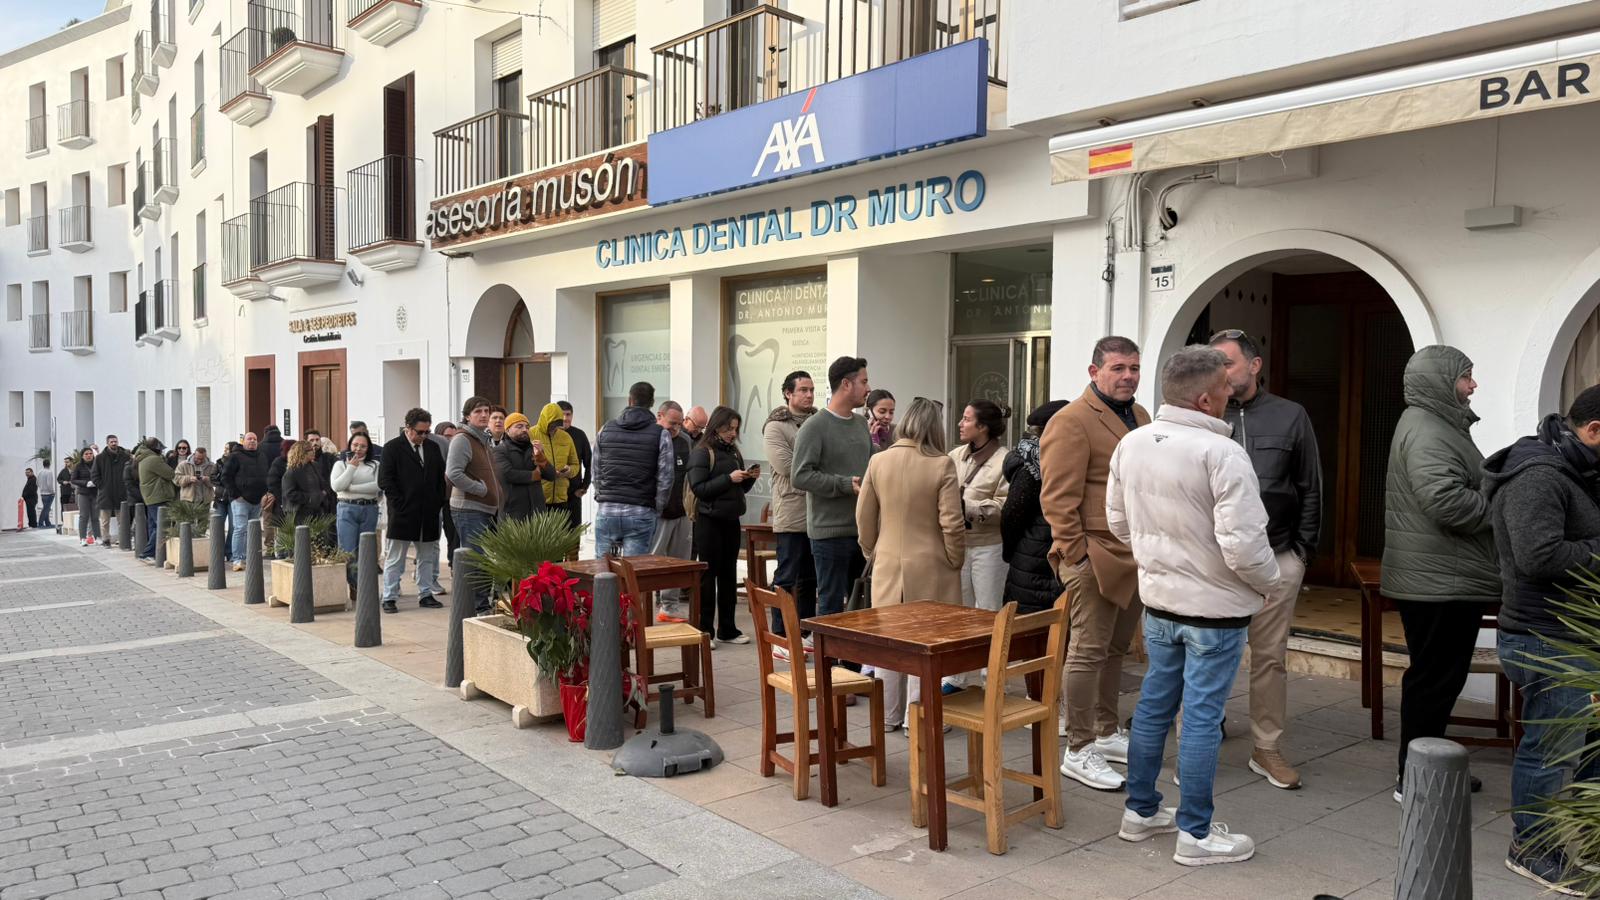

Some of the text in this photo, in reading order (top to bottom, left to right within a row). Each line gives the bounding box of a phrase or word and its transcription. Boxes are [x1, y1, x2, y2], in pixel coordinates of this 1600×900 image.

[1480, 62, 1590, 110] BAR
[752, 110, 824, 178] AXA
[424, 152, 634, 240] asesoría musón
[596, 169, 986, 268] CLINICA DENTAL DR MURO
[739, 288, 782, 306] CLINICA
[1154, 276, 1169, 288] 15
[758, 305, 803, 318] ANTONIO
[993, 304, 1052, 316] ANTONI
